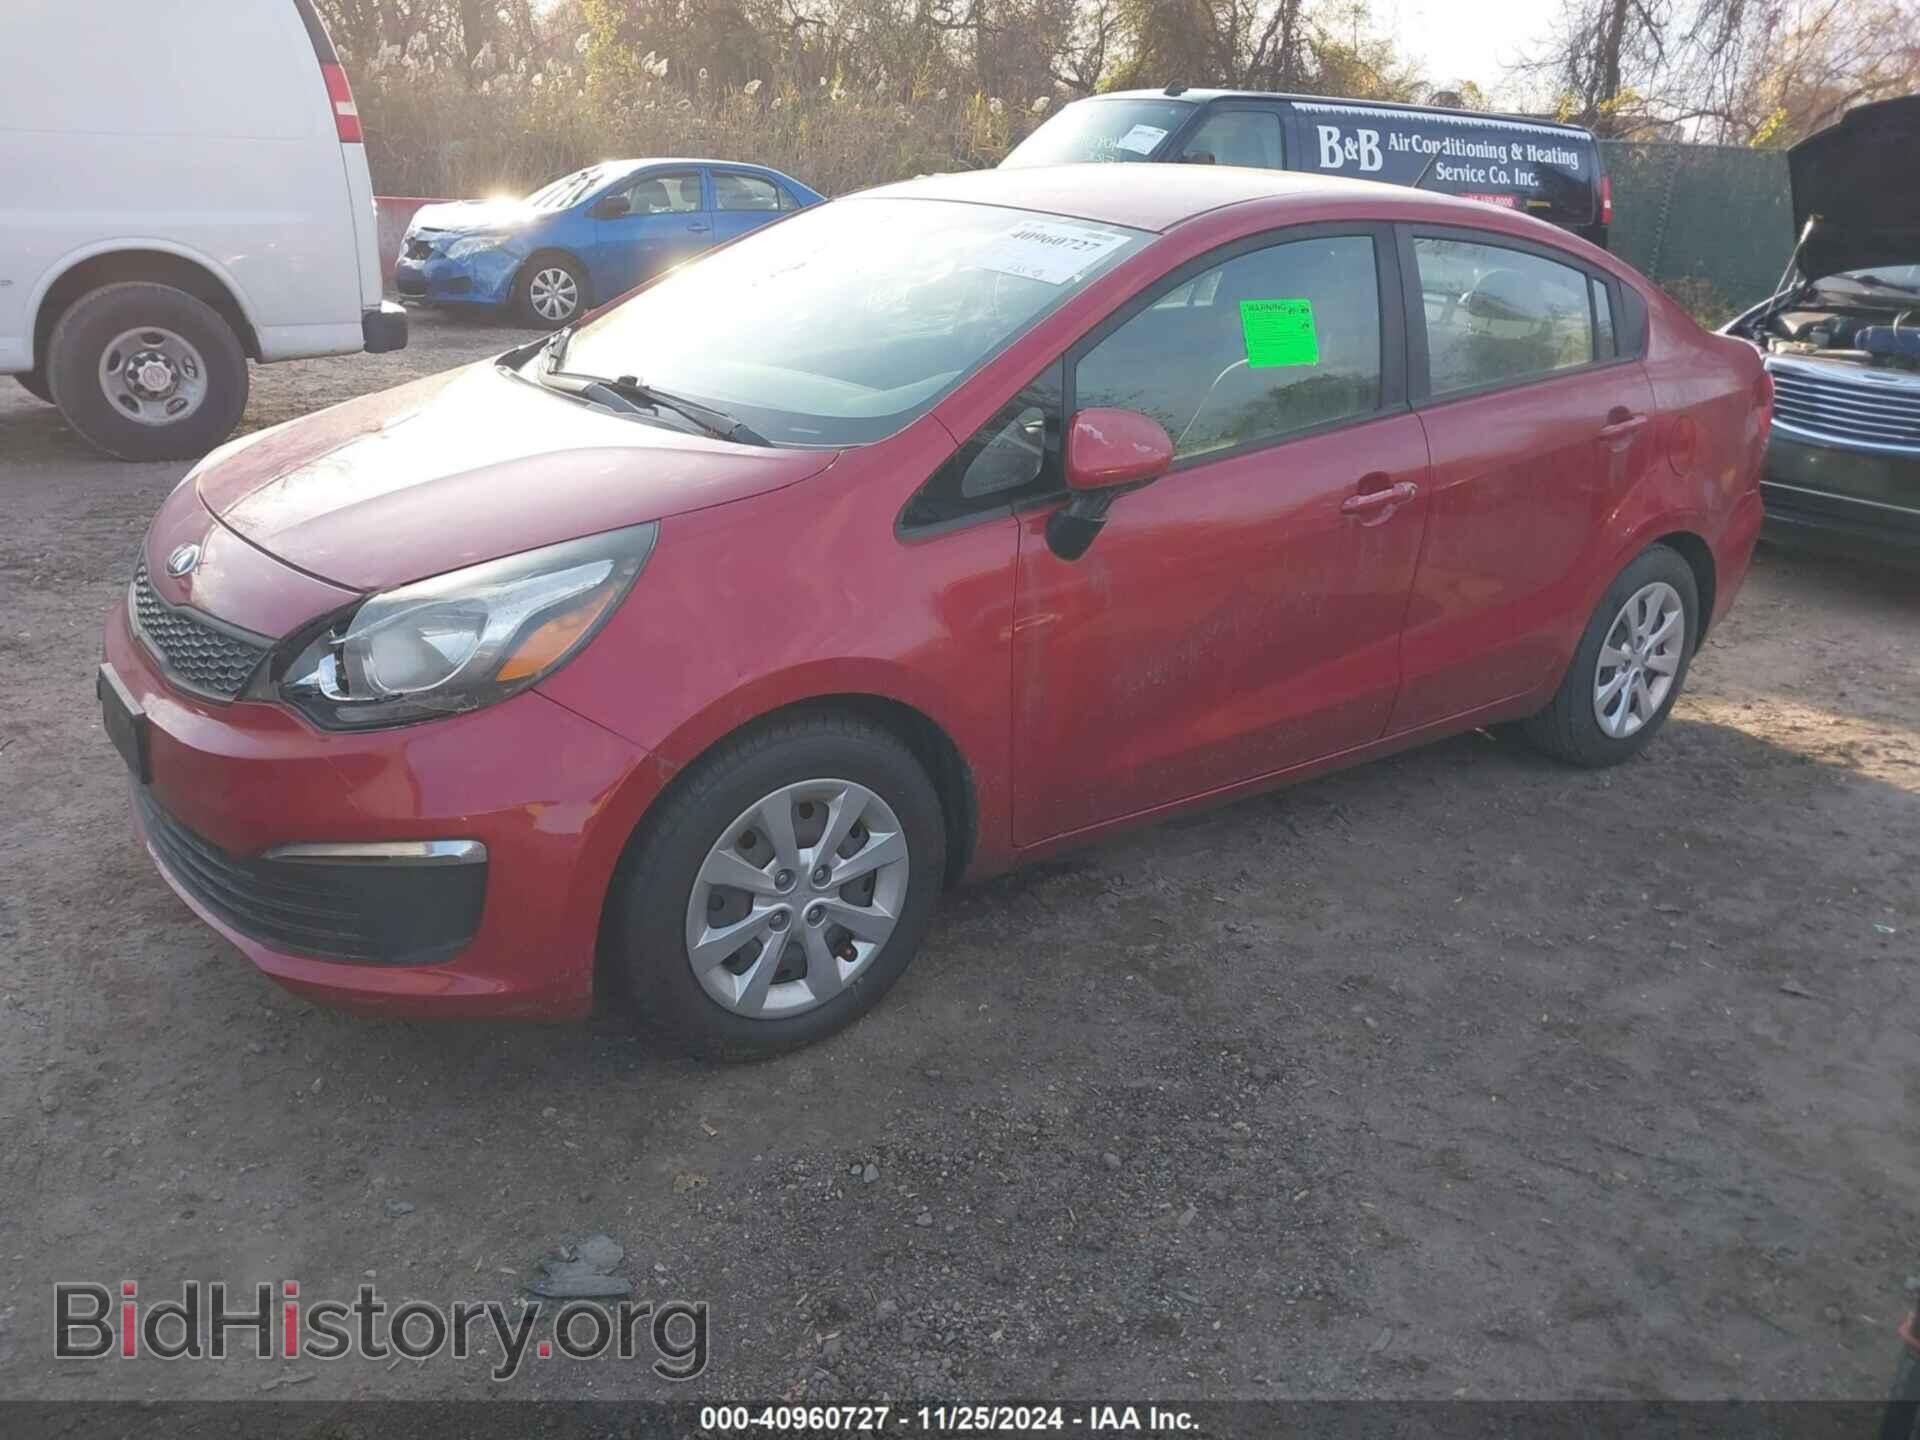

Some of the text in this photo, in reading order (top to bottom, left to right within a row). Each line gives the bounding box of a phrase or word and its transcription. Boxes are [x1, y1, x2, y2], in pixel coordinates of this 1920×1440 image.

[1317, 125, 1383, 171] B&B
[1511, 143, 1524, 160] &
[1526, 144, 1579, 169] Heating
[1436, 162, 1539, 187] Service Co. Inc.
